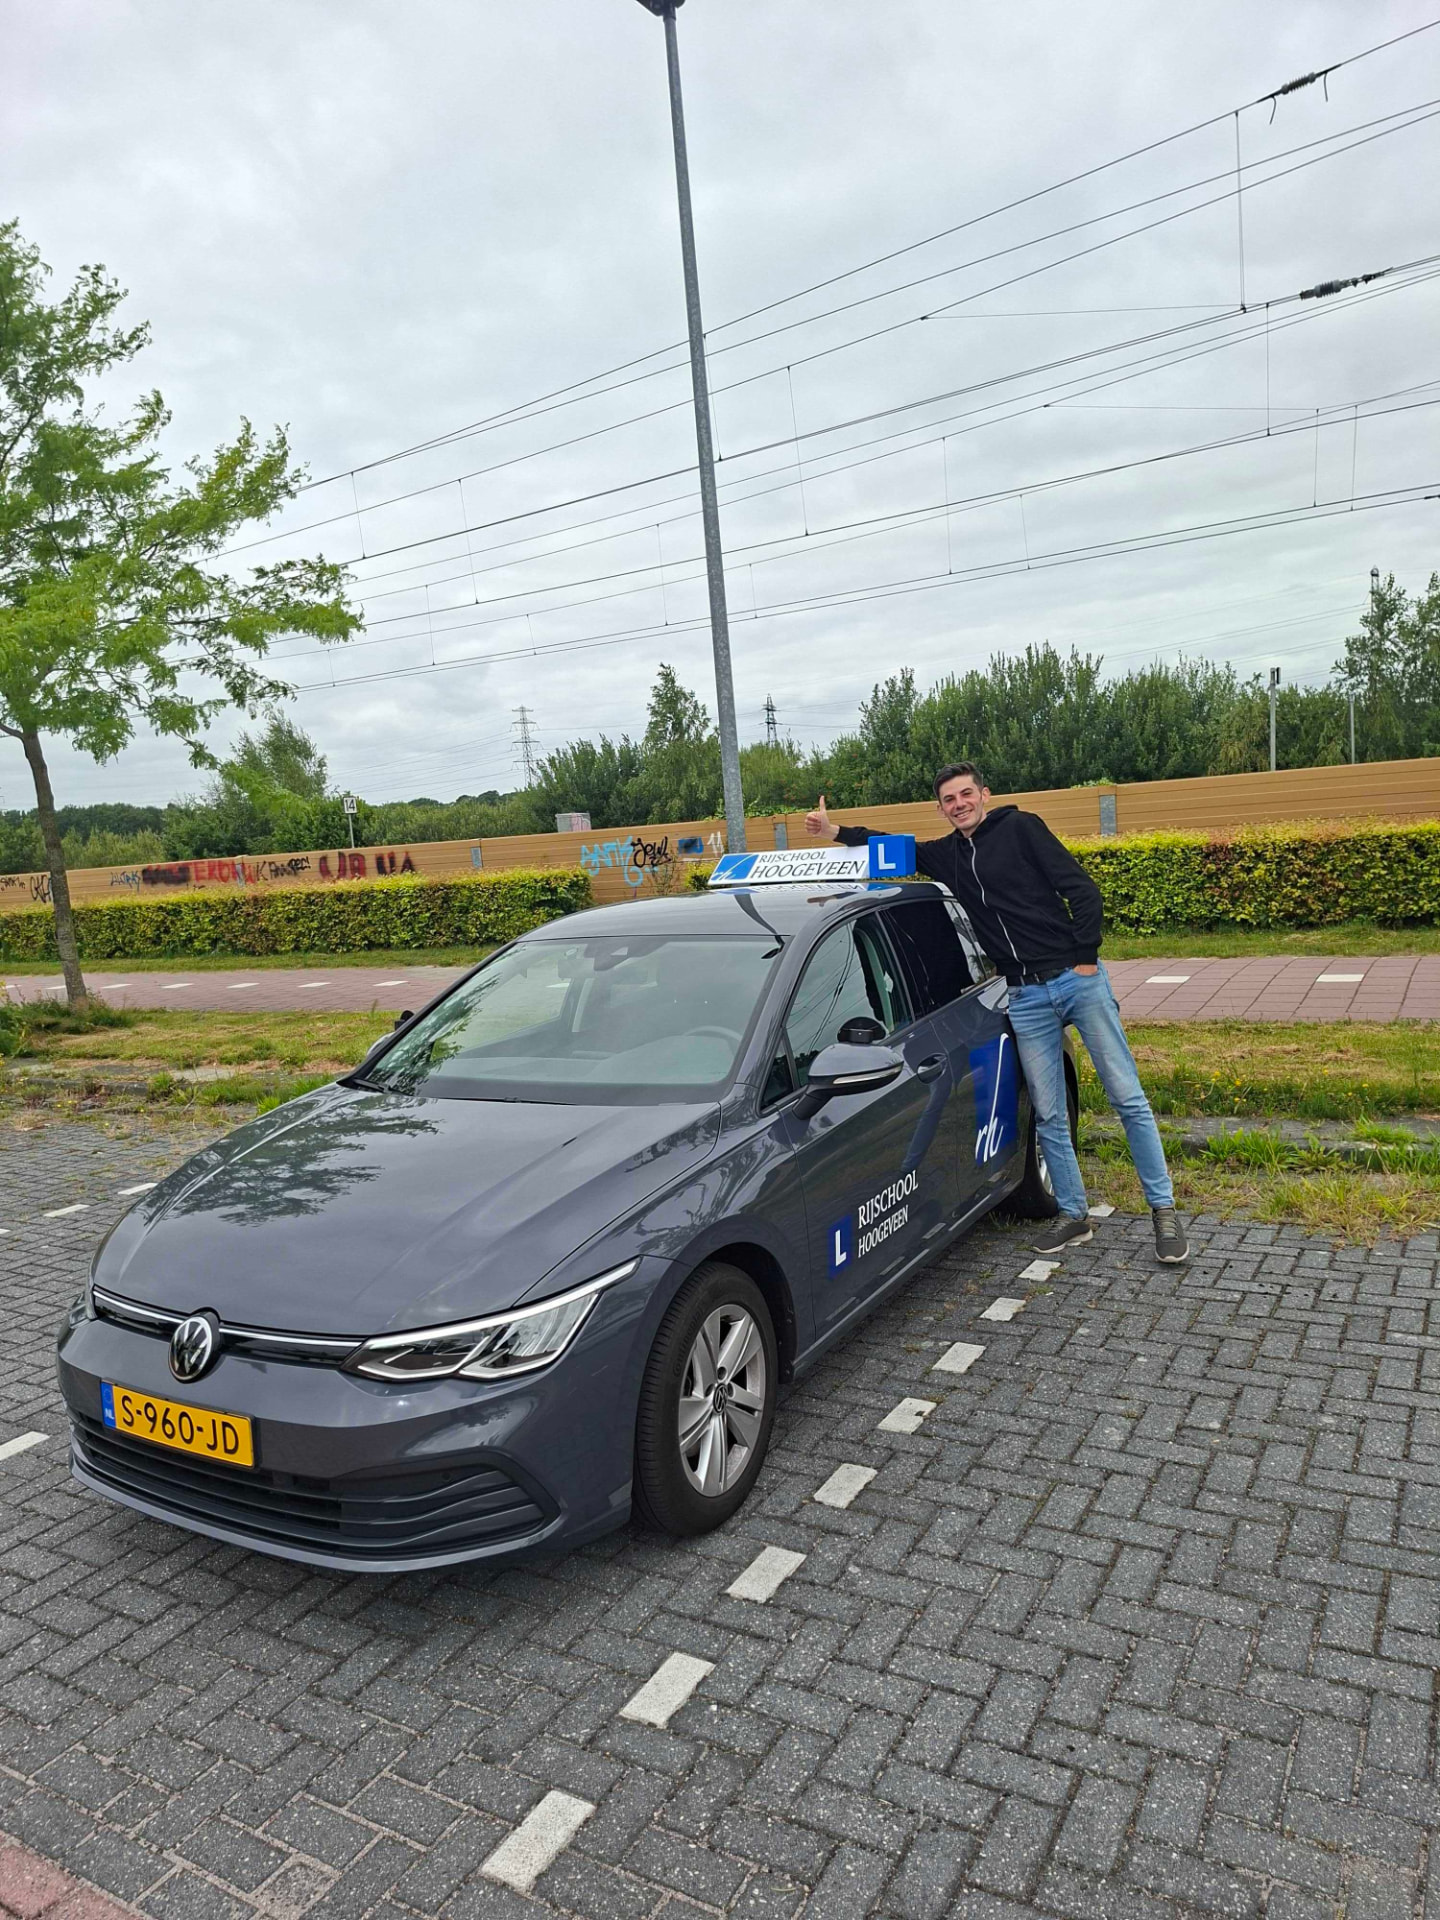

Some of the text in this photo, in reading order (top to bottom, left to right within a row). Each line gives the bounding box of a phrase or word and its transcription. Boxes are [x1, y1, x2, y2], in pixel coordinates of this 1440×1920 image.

[344, 800, 356, 811] 14
[751, 860, 866, 879] HOOGEVEEN
[758, 851, 827, 864] RIJSCHOOL
[877, 843, 896, 870] L
[857, 1170, 919, 1229] RIJSCHOOL
[857, 1204, 909, 1258] HOOGEVEEN
[835, 1229, 847, 1267] L
[105, 1407, 115, 1420] NL
[121, 1395, 240, 1455] S-960-JD
